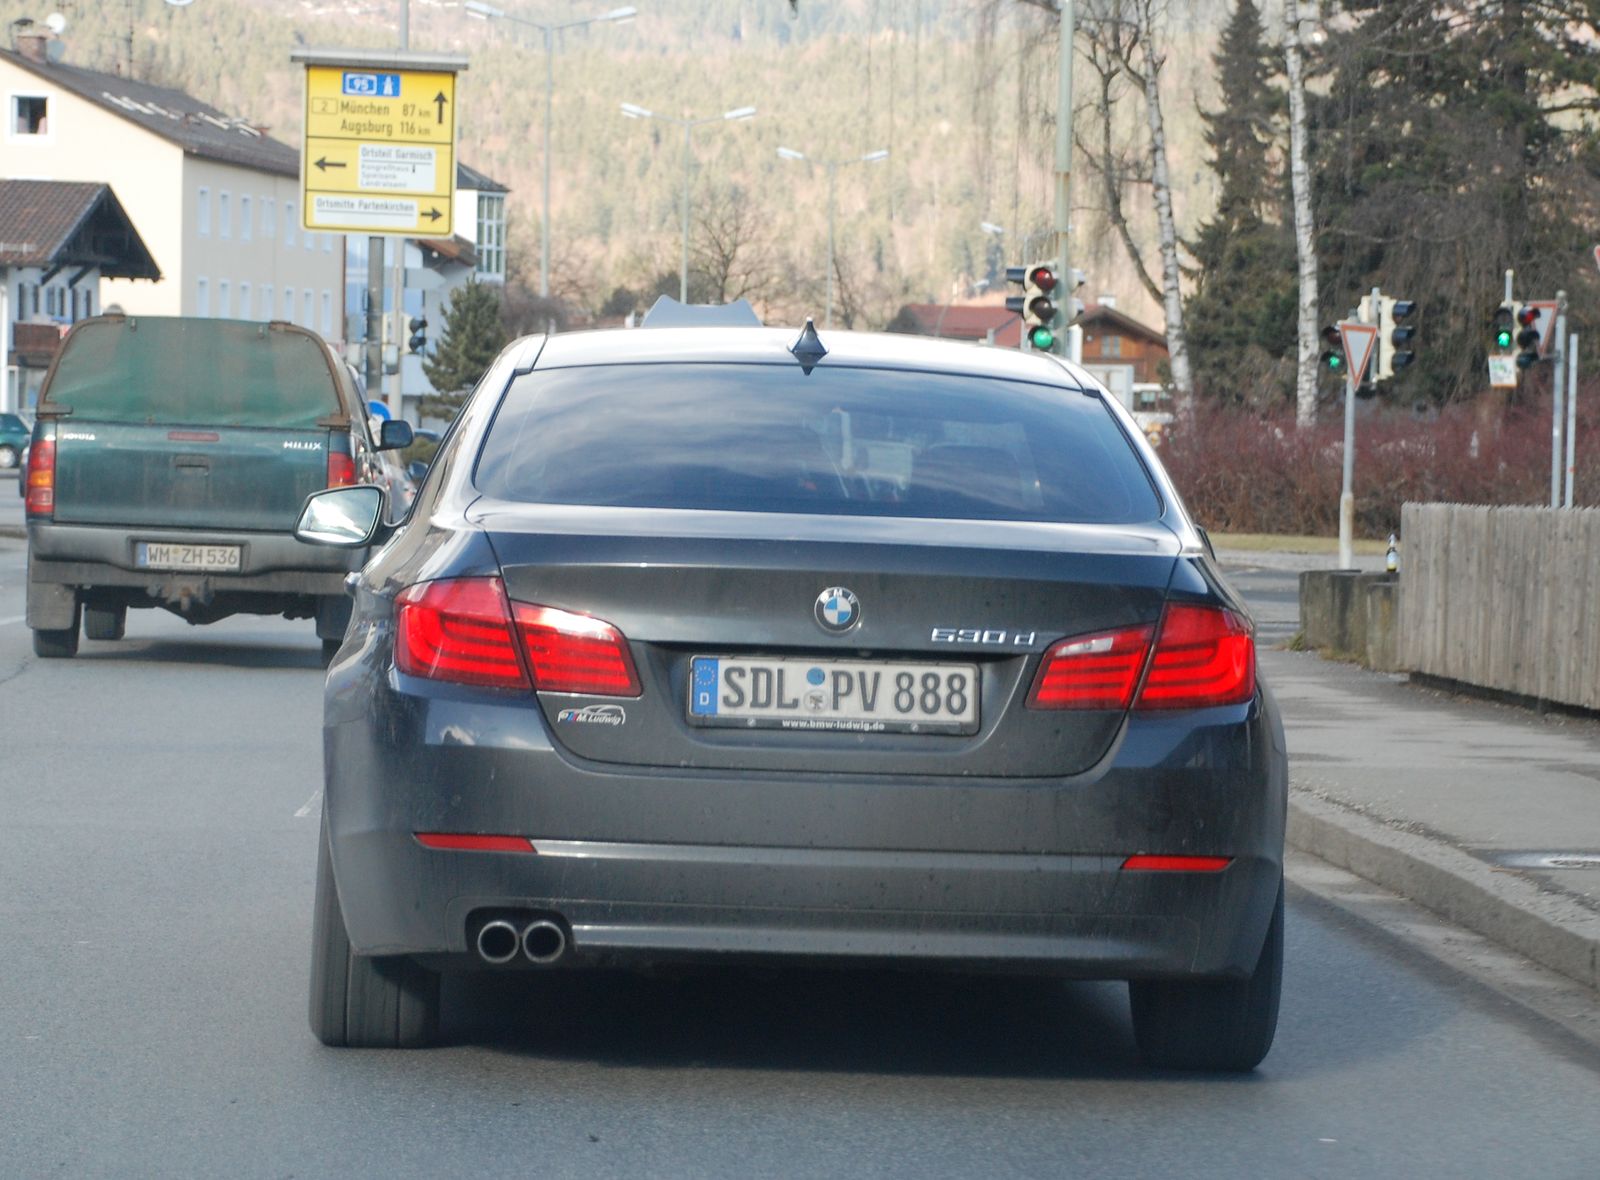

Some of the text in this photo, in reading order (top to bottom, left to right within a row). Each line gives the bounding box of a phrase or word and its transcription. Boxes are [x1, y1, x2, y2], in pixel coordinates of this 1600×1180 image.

[353, 78, 368, 92] 95
[341, 100, 431, 118] München 87 km
[340, 118, 431, 137] Augsburg 116 km
[395, 149, 433, 161] Garmisch
[316, 197, 415, 212] Ortsmitte Partenkirchen
[283, 440, 322, 451] HILUX
[148, 546, 238, 566] WM ZH 536
[721, 666, 967, 716] SDL PV 888
[700, 692, 710, 706] D
